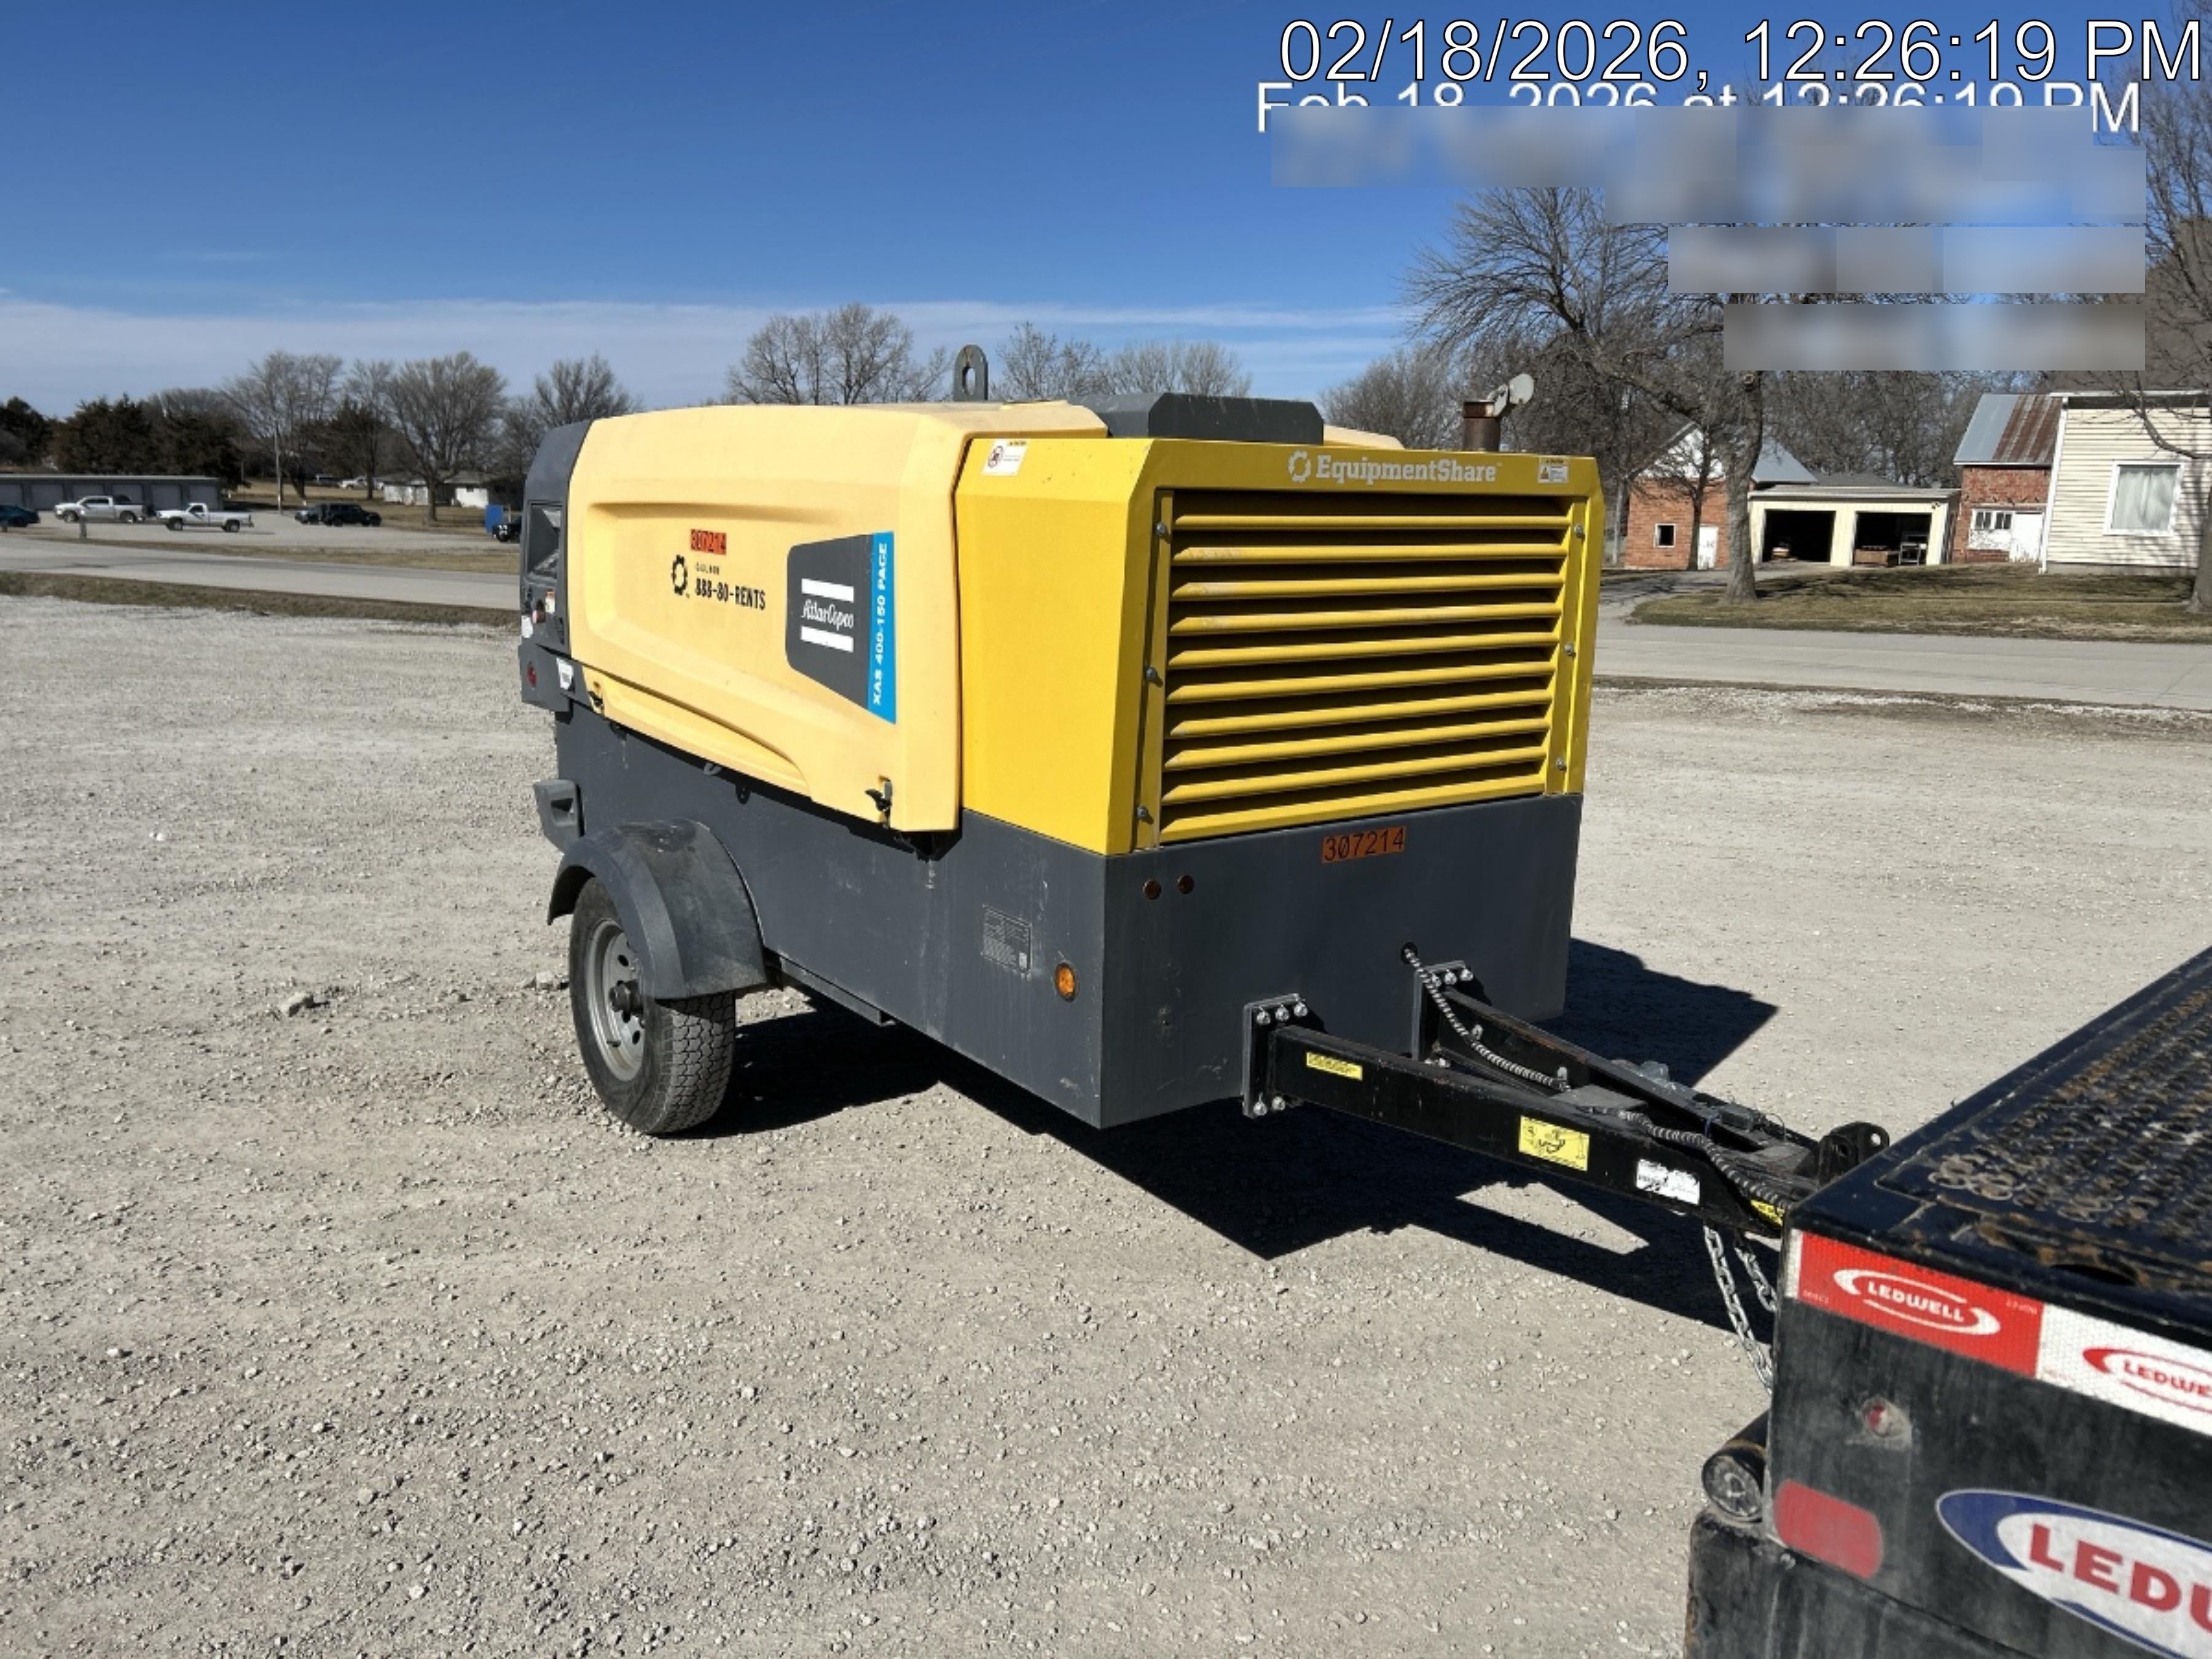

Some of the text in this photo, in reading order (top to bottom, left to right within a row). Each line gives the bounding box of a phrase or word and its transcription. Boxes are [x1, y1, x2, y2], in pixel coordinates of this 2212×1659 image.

[1316, 455, 1496, 485] EquipmentShare
[873, 543, 887, 705] XAS 400-150 PACE
[1325, 828, 1404, 861] 307214
[1867, 1281, 1964, 1322] LEDWELL
